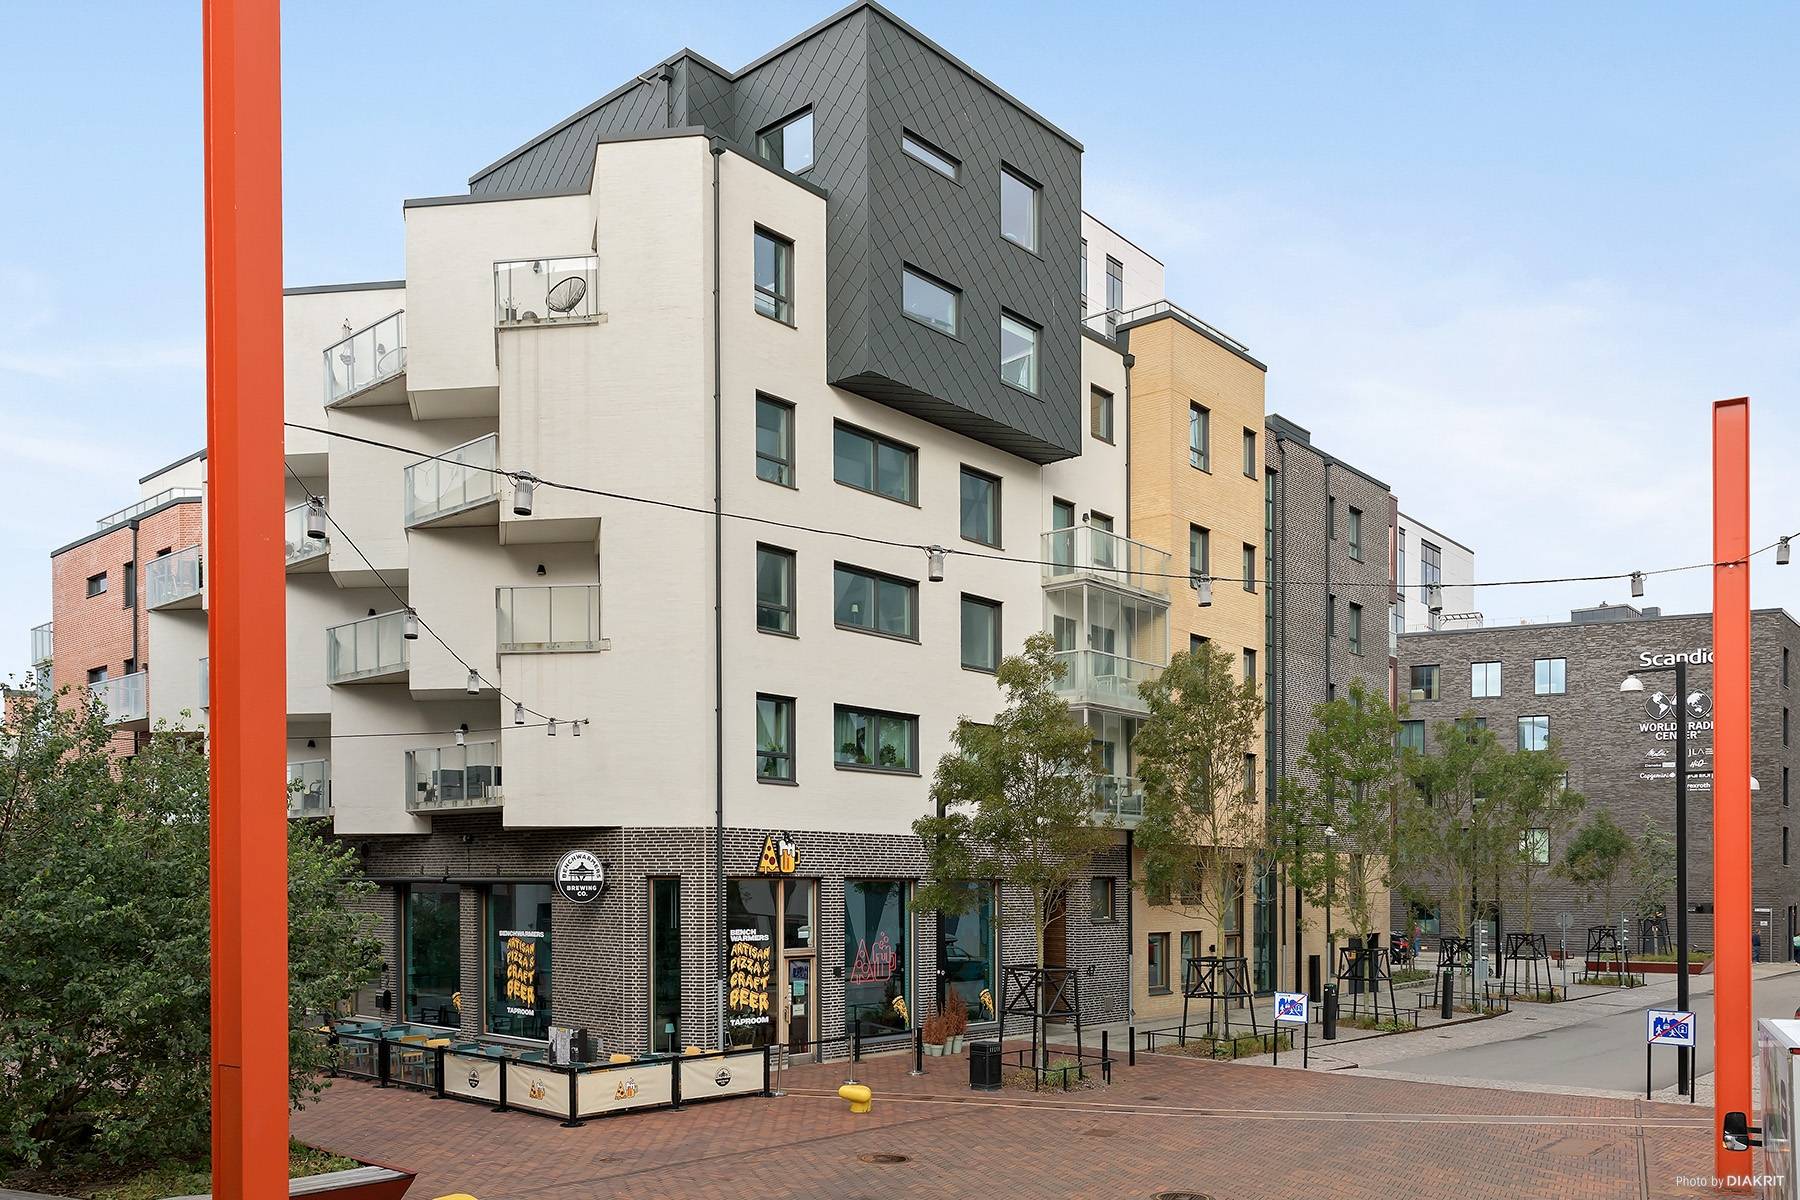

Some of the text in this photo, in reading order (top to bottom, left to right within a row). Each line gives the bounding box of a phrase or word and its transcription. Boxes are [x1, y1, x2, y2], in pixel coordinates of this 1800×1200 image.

[1639, 721, 1714, 732] WORLD RAD
[1655, 731, 1698, 740] CENR
[507, 937, 535, 955] ARTISAN
[730, 942, 770, 960] ARTISAN
[506, 950, 529, 969] PIZZA
[730, 956, 770, 976] PIZZA &
[506, 963, 535, 984] CRAFT
[730, 971, 770, 991] CRAFT
[507, 979, 535, 1009] BEER
[729, 987, 770, 1016] BEER
[507, 1007, 535, 1016] TAPROOM
[730, 1016, 769, 1026] TAPROOM
